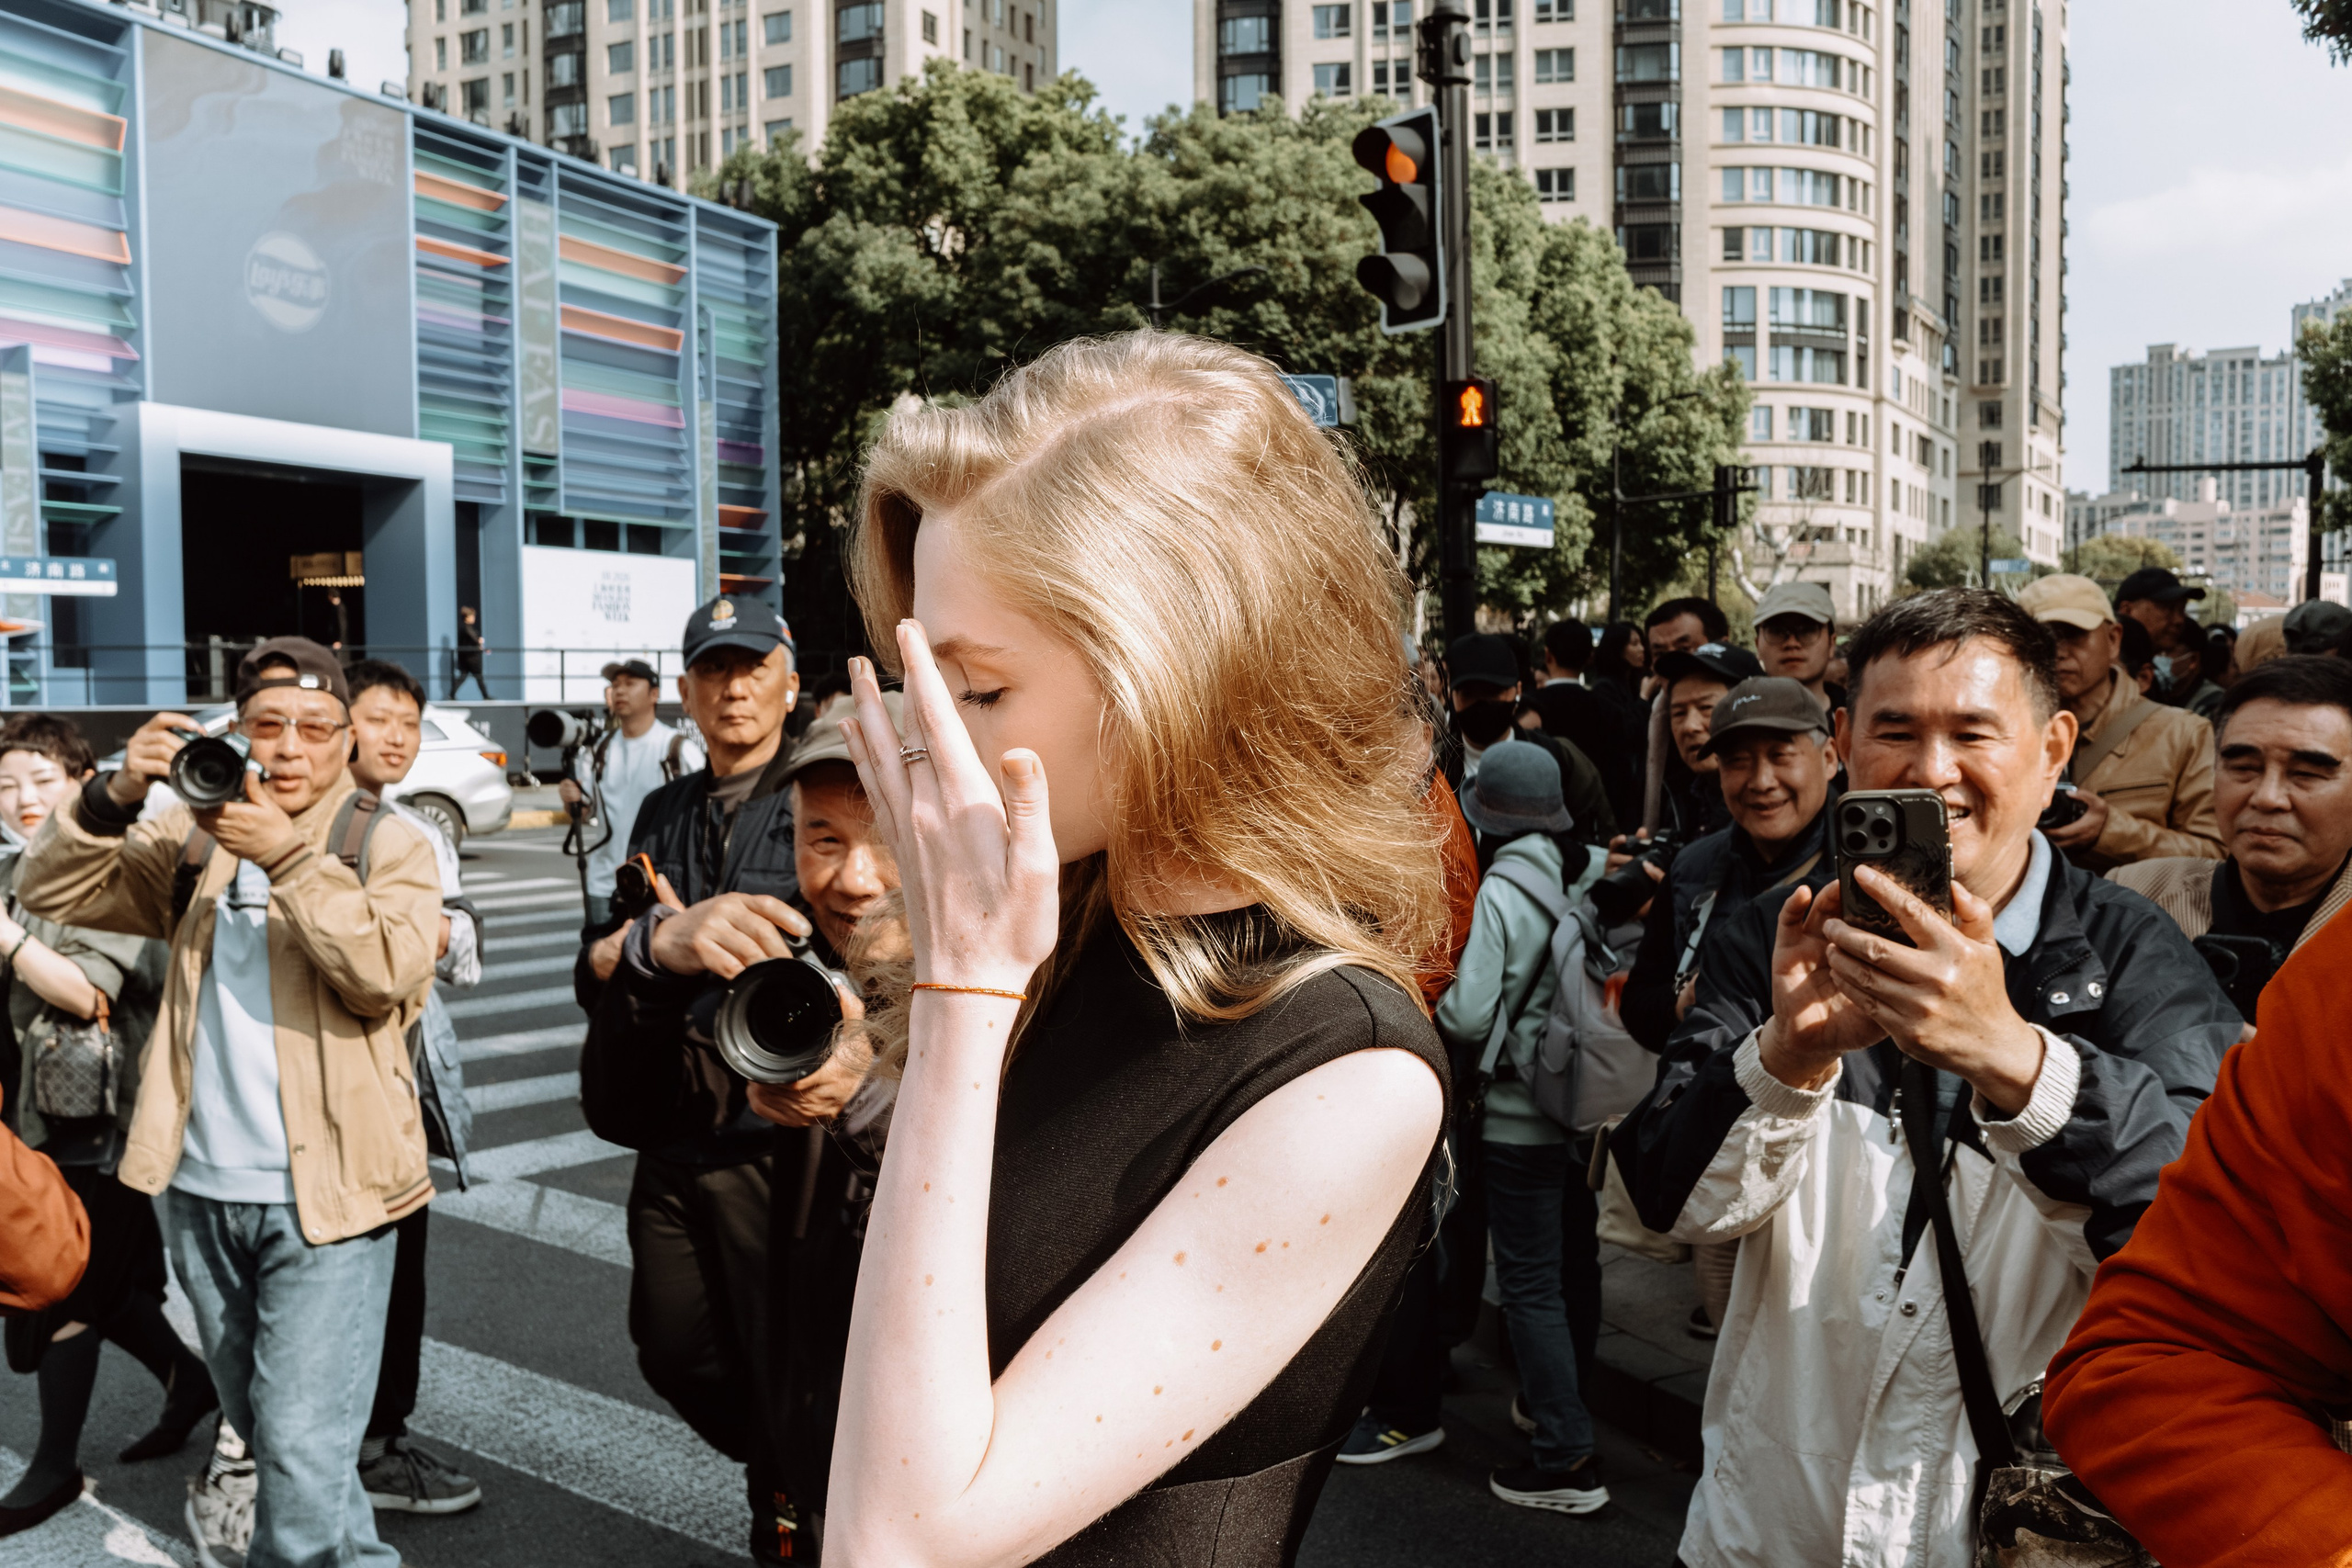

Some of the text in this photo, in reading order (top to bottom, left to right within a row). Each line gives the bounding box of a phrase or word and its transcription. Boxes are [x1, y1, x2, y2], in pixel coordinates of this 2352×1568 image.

[1492, 499, 1534, 525] 济南路
[24, 561, 86, 580] 济南路
